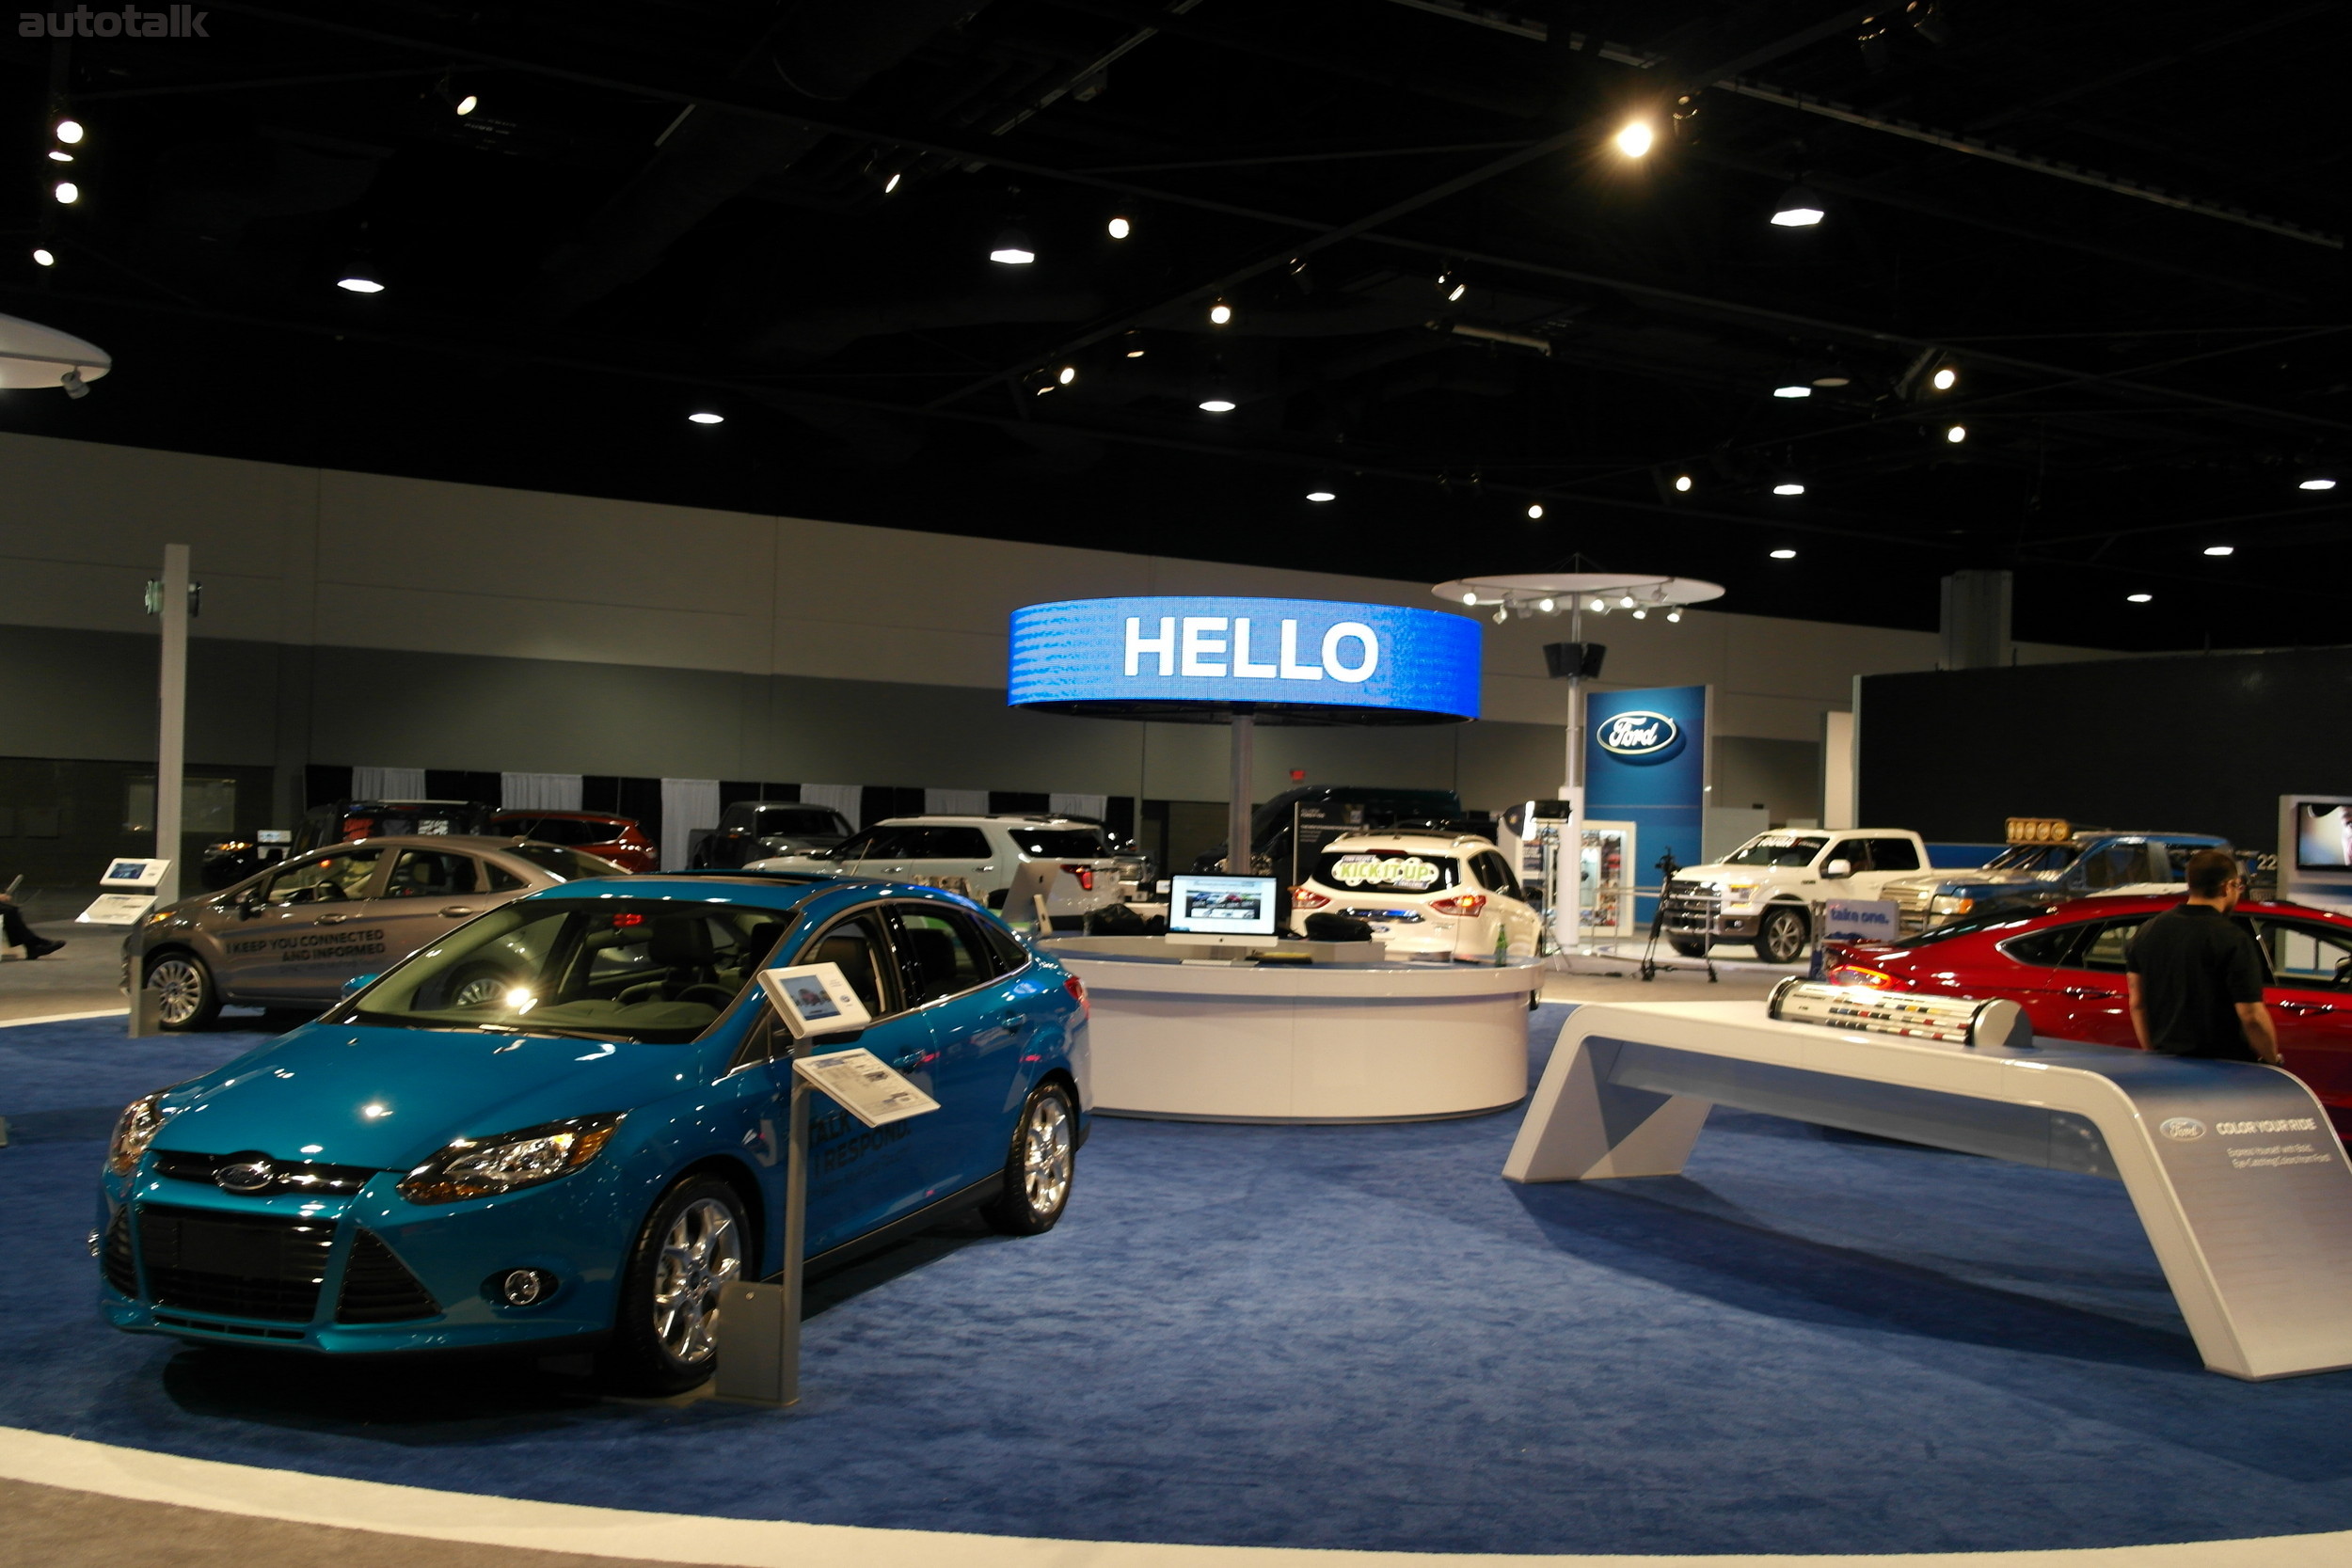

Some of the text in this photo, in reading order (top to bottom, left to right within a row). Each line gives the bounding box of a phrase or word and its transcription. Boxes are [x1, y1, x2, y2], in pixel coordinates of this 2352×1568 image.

[1124, 616, 1379, 683] HELLO
[1608, 717, 1660, 747] Ford
[1340, 863, 1430, 880] KICK IT UP
[1831, 908, 1890, 926] take one.
[232, 940, 266, 954] KEEP
[269, 938, 299, 950] YOU
[299, 928, 385, 947] CONNECTED
[282, 942, 386, 962] AND INFORMED
[2216, 1117, 2317, 1135] COLOR YOUR RIDE
